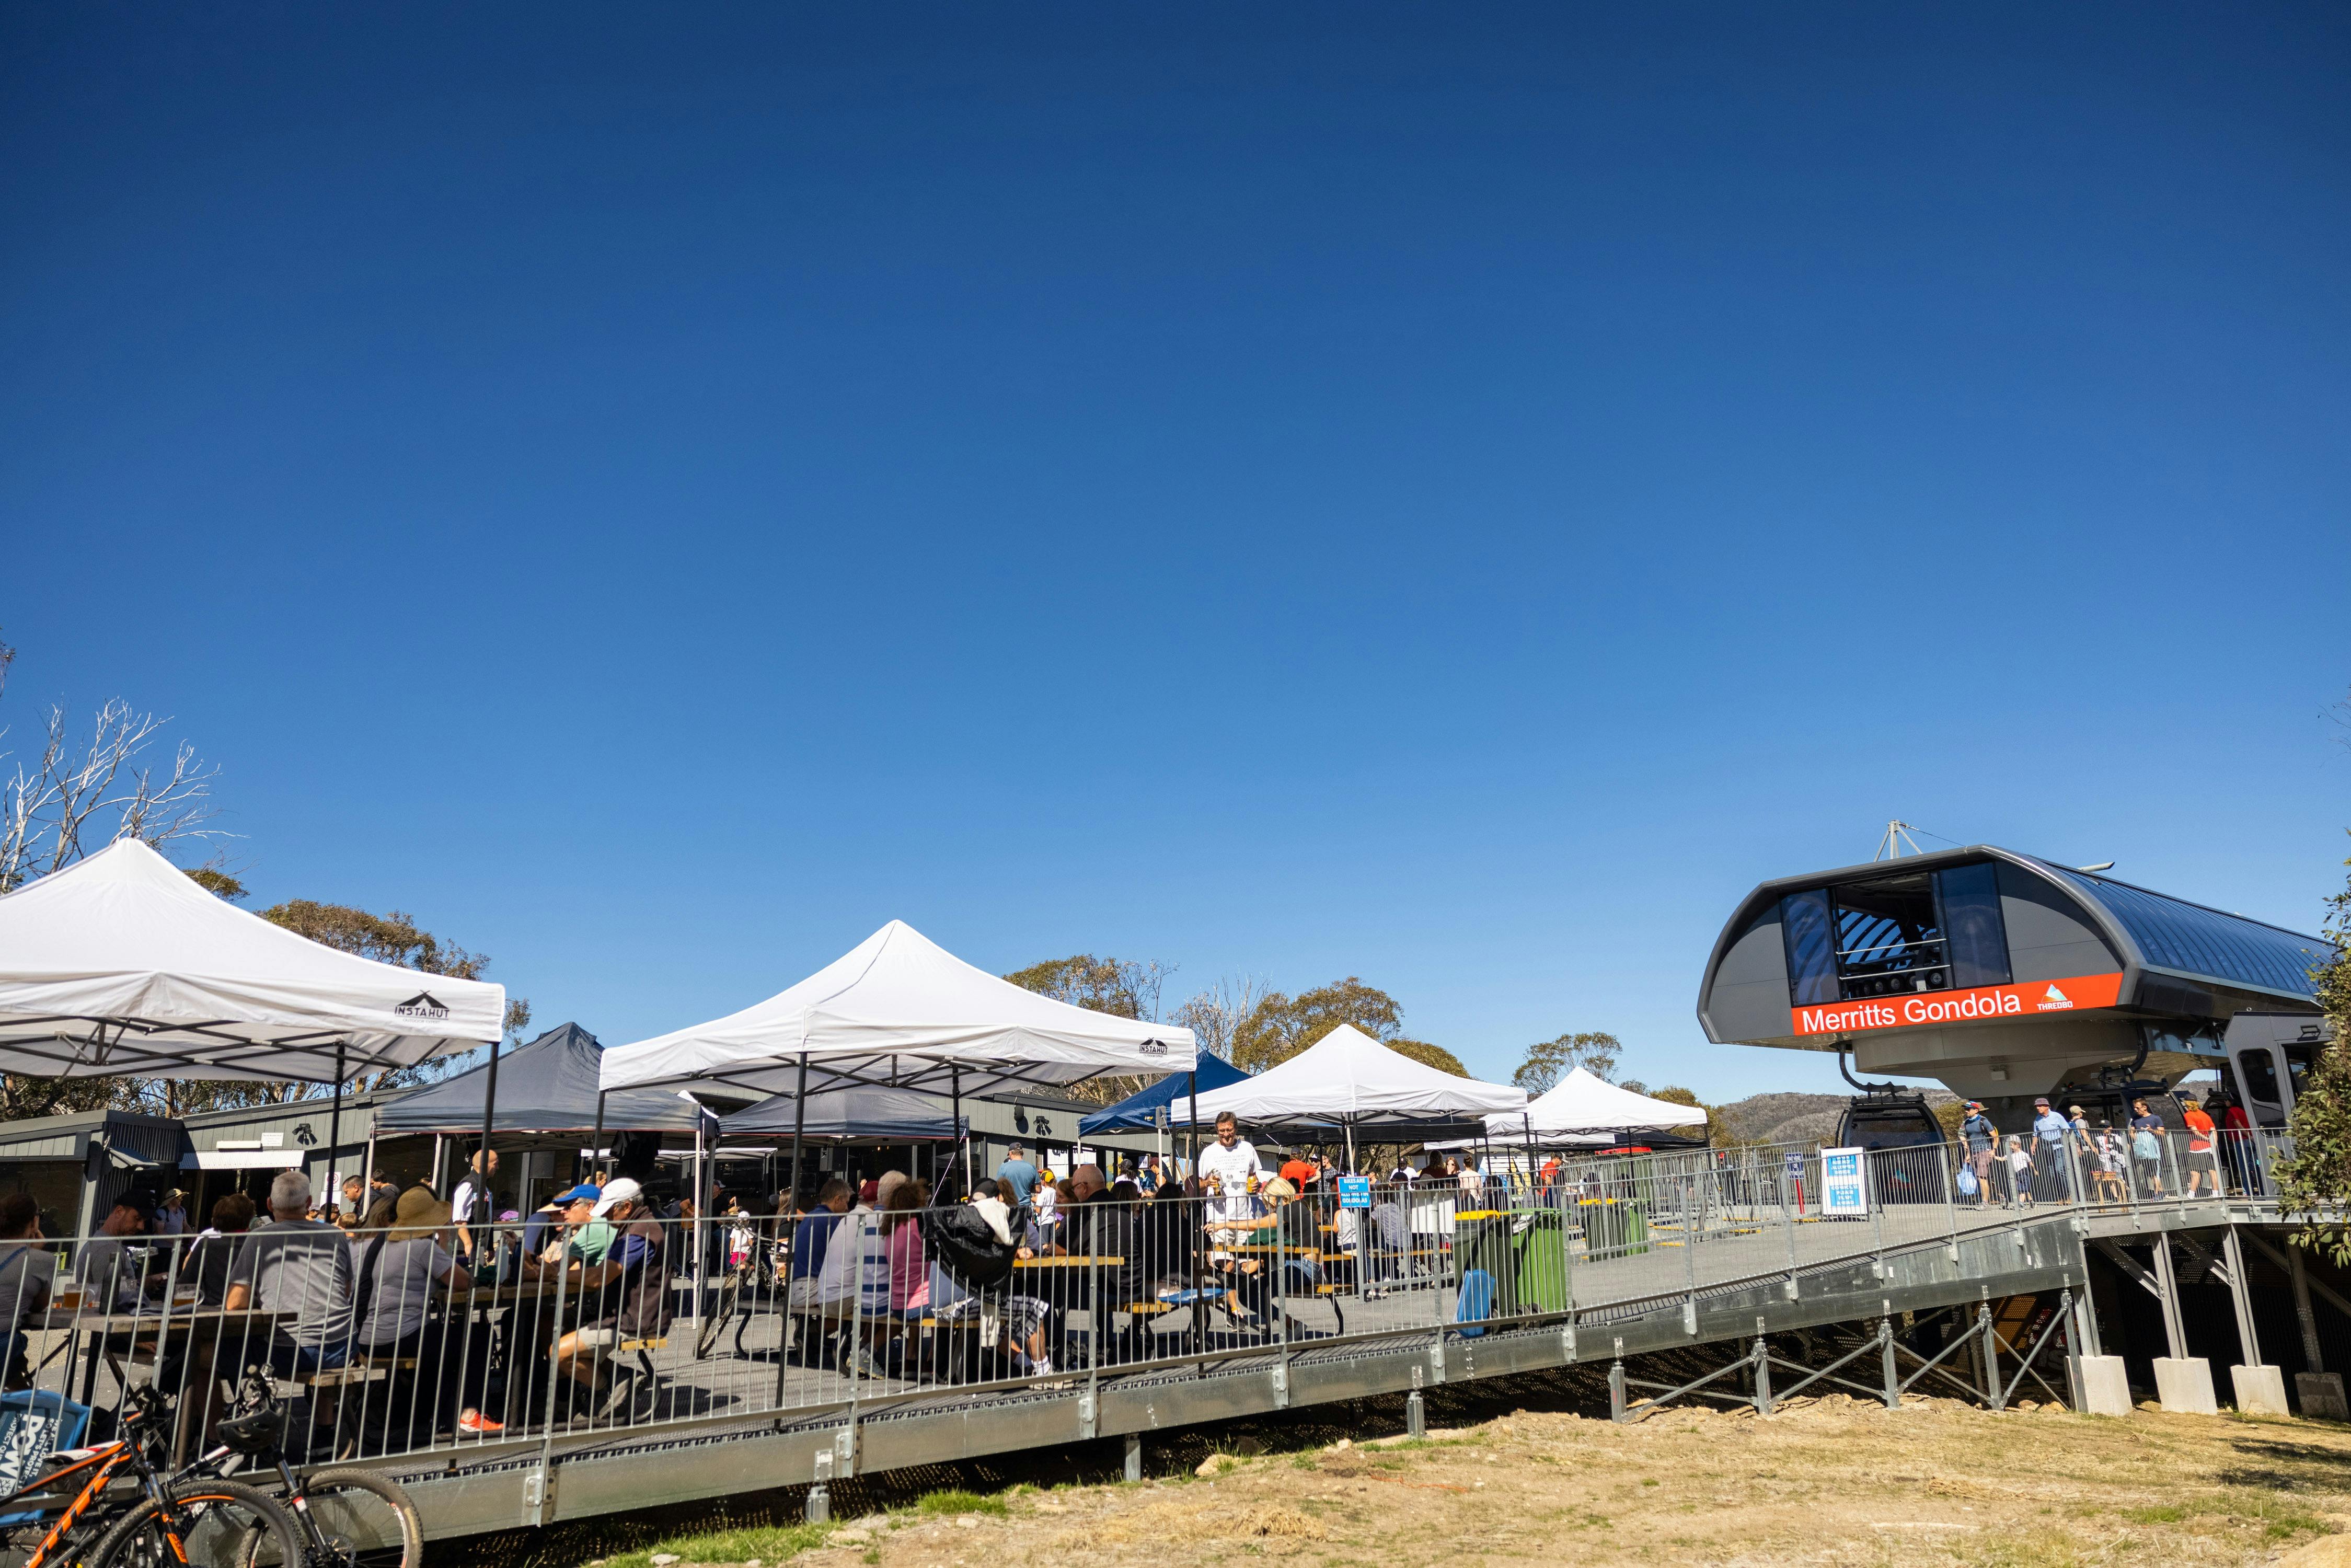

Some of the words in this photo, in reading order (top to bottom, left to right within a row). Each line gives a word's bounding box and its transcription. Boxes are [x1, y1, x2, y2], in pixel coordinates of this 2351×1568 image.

[394, 1006, 450, 1018] INSTAHUT
[1802, 1004, 1896, 1033] Merritts
[1904, 990, 2021, 1022] Gondola
[2036, 1000, 2073, 1011] THREDBO
[45, 1418, 55, 1428] SO
[34, 1429, 49, 1449] LET'S
[44, 1432, 55, 1446] ALL
[34, 1447, 49, 1468] LOVE
[29, 1468, 39, 1477] IT,
